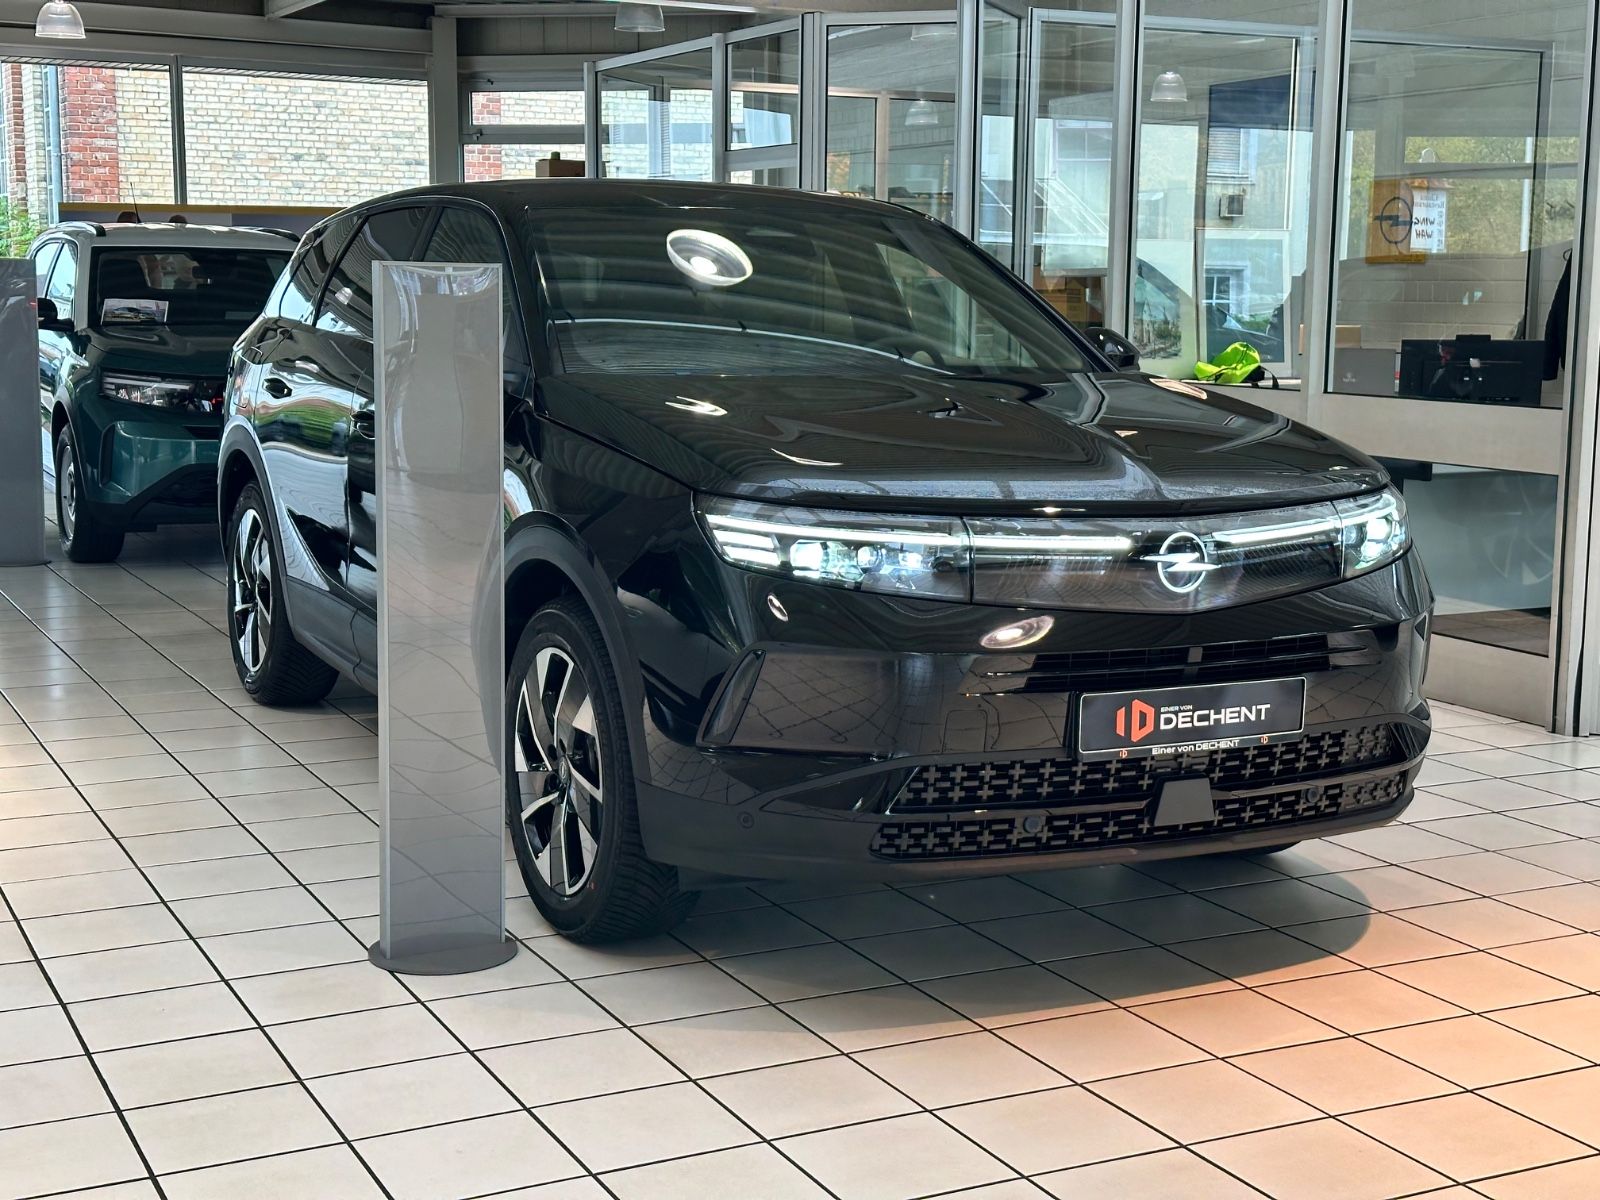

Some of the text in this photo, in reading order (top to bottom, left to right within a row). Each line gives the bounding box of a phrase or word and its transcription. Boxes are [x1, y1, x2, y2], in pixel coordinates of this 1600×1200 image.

[1160, 703, 1271, 730] DECHENT
[1152, 740, 1240, 755] Einer von DECHENT
